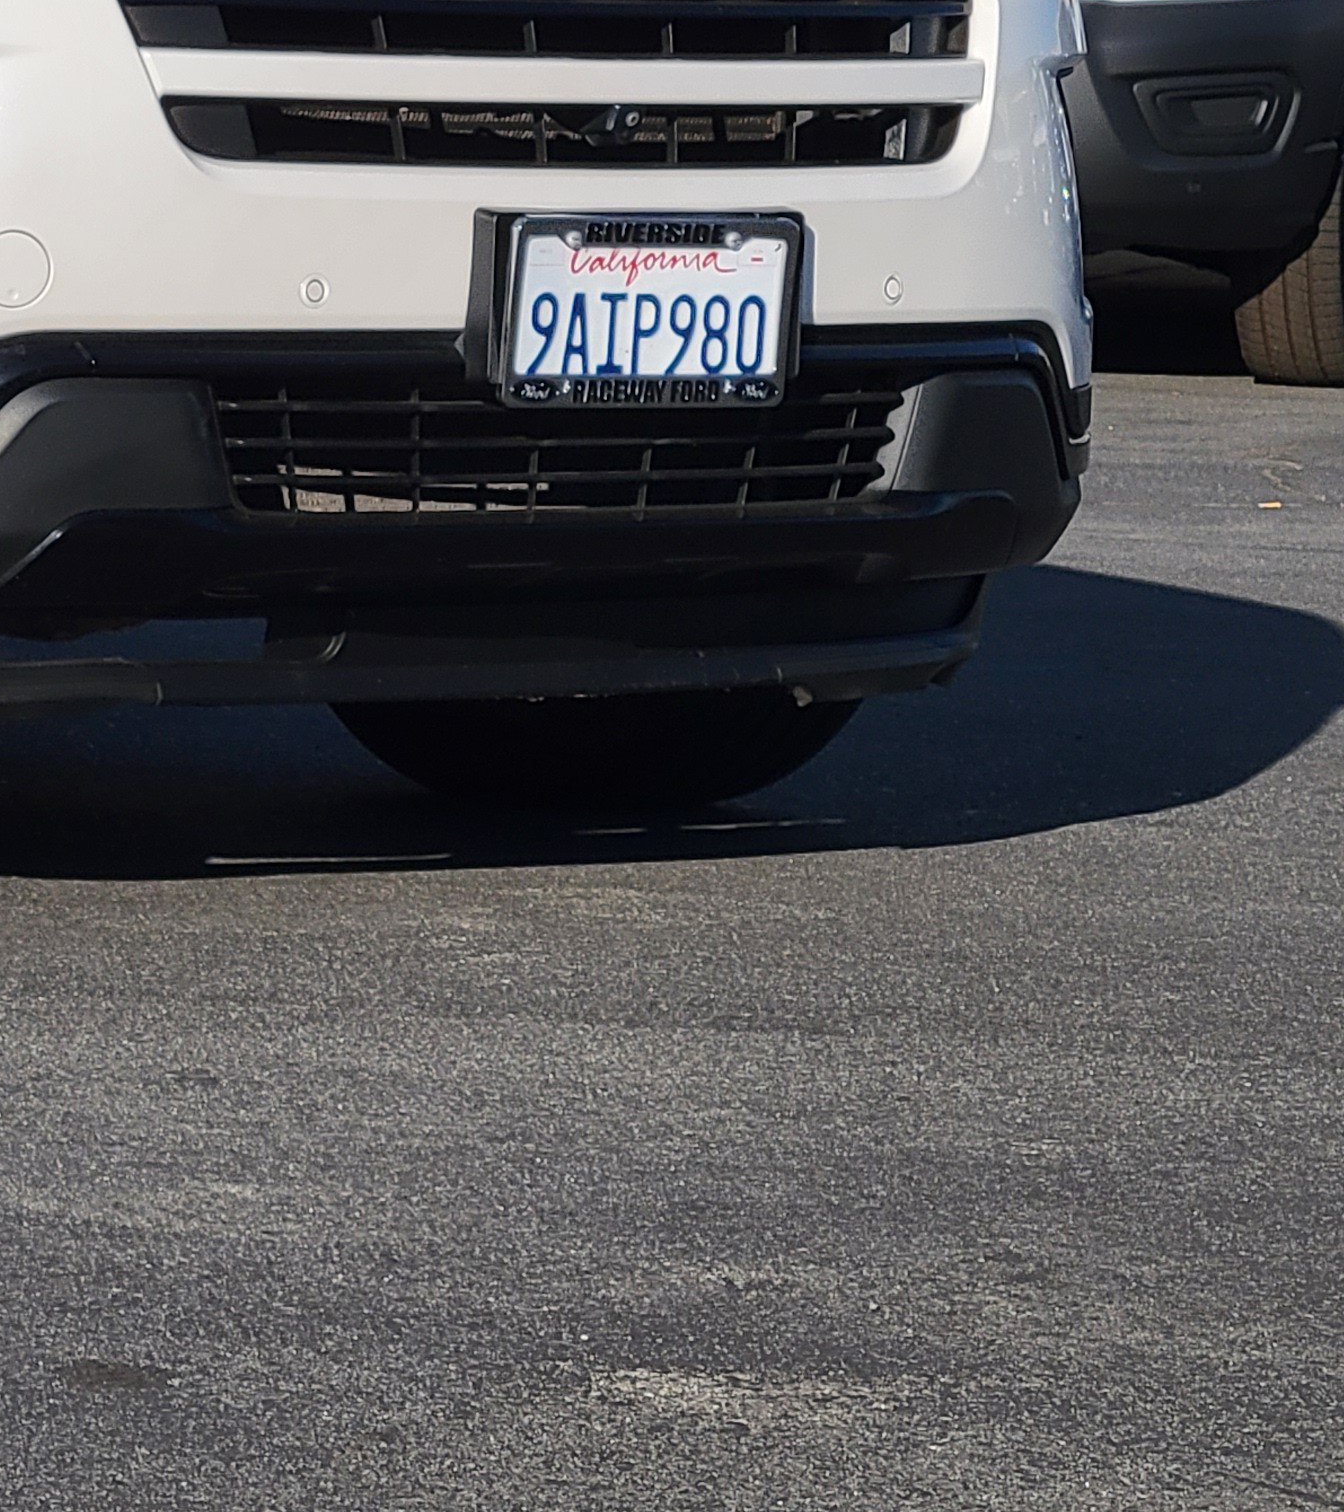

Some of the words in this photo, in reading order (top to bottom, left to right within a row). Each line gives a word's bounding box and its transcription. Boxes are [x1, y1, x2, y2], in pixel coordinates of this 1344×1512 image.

[585, 222, 726, 245] RIVERSIDE
[569, 246, 738, 287] California
[525, 291, 767, 376] 9AIP980
[571, 380, 668, 404] RACEWAY
[669, 380, 720, 403] FORD
